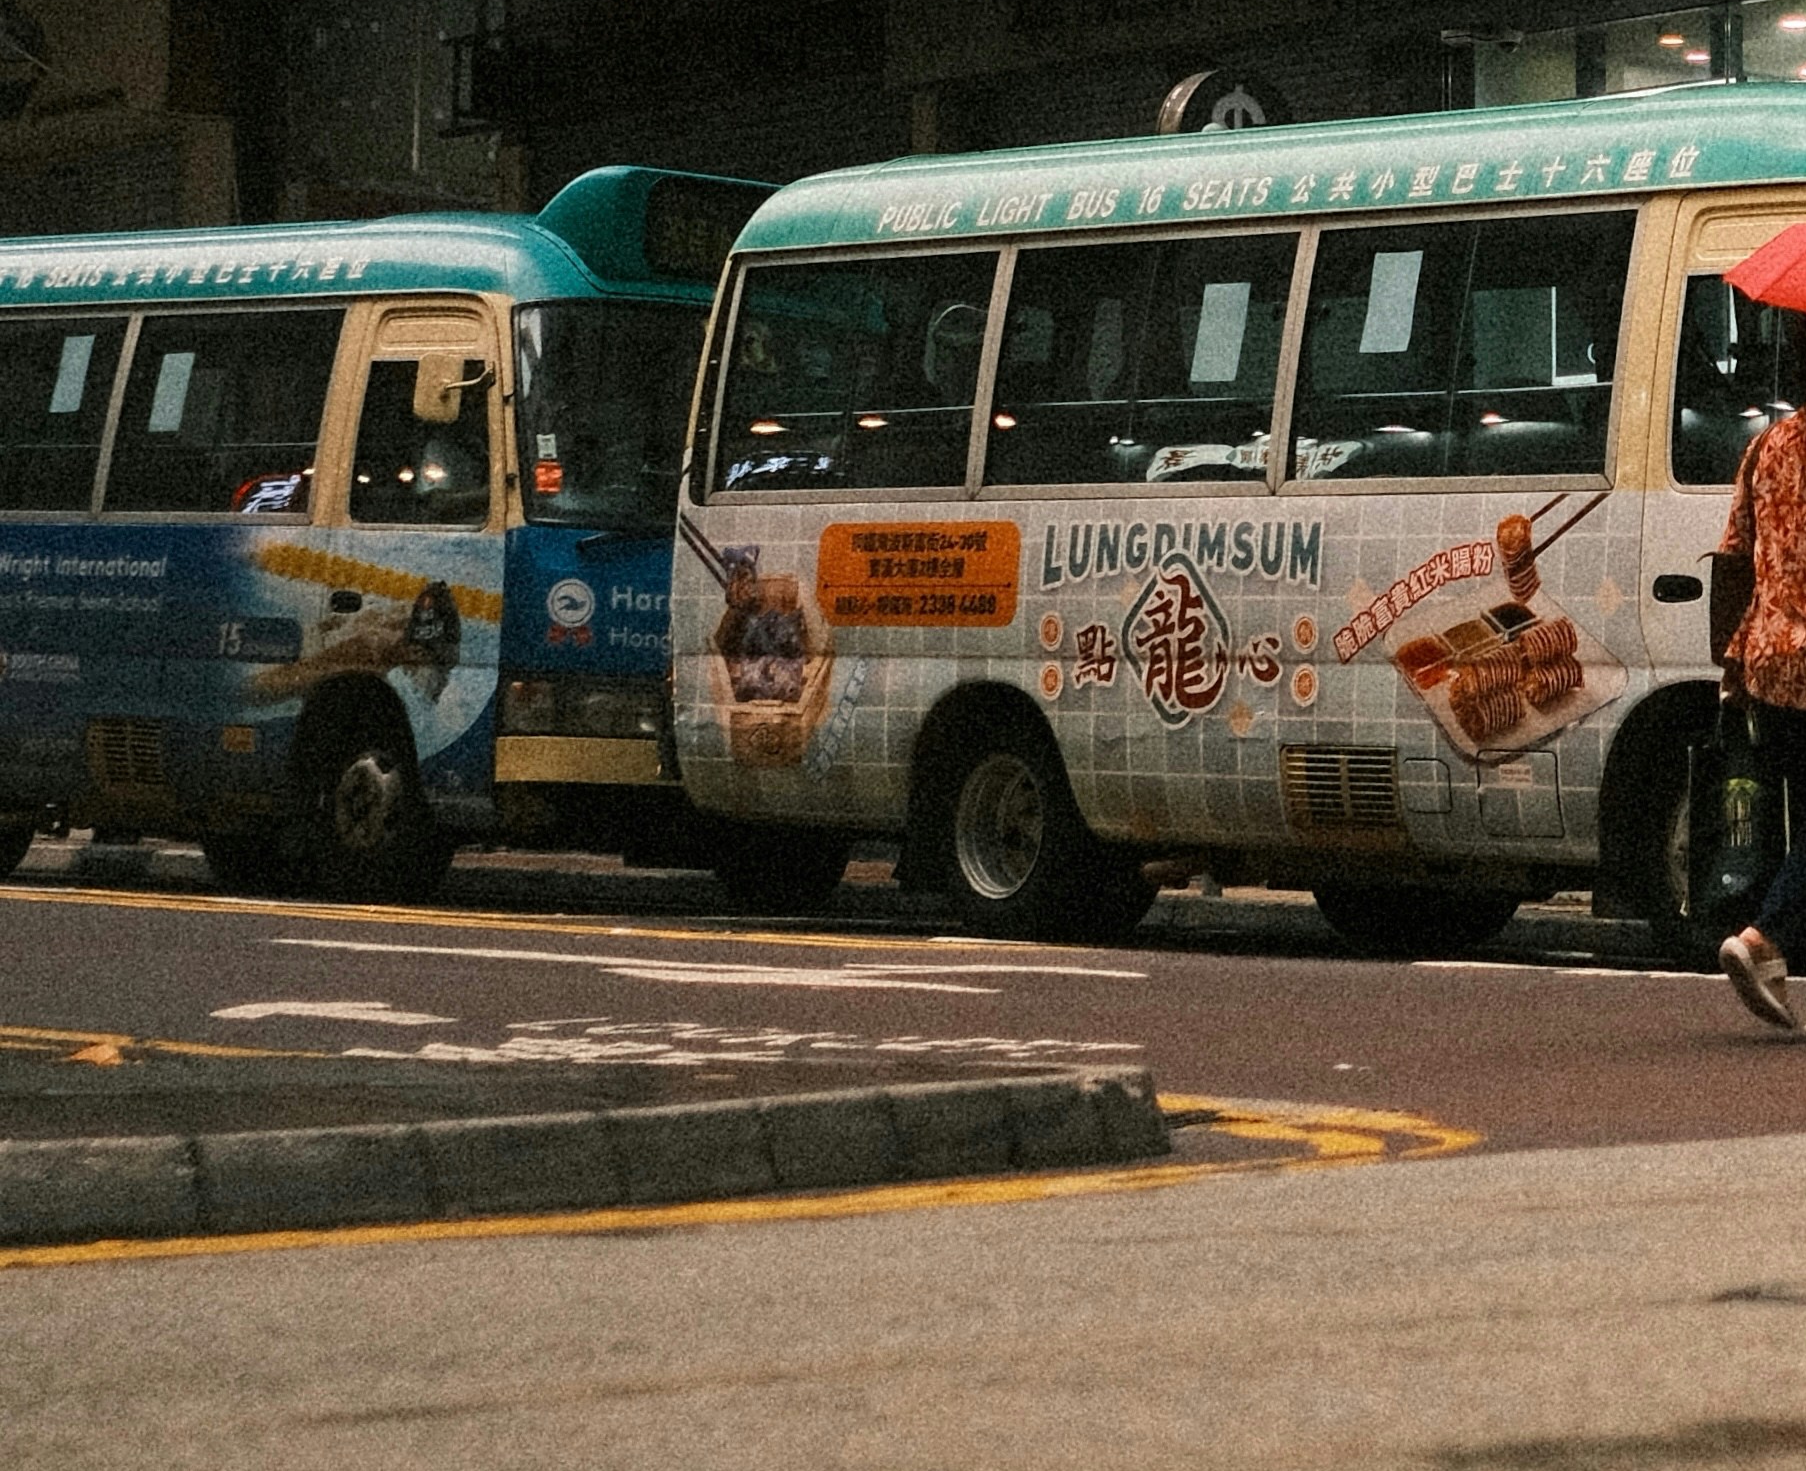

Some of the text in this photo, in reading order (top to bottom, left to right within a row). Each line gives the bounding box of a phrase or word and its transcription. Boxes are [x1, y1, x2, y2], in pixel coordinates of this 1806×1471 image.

[876, 146, 1700, 233] PUBLIC LIGHT BUS 16 SEATS 公共小型巴士十六座位
[56, 556, 168, 578] International
[1042, 521, 1322, 587] LUNGDIMSUM
[1333, 542, 1495, 665] 脆脆富貴紅米腸粉
